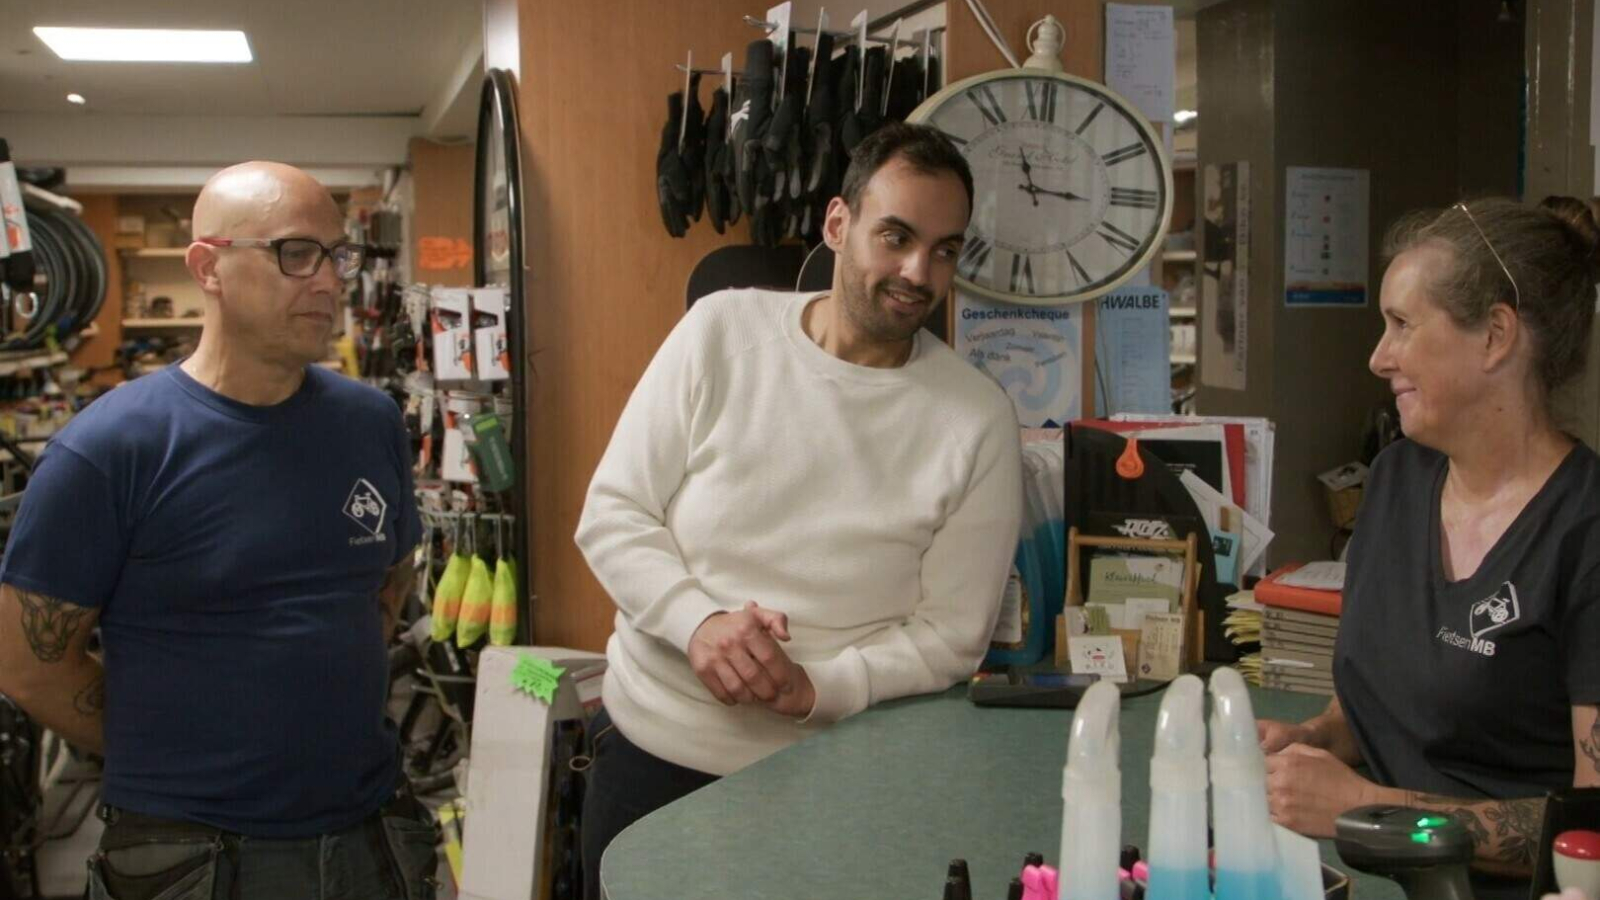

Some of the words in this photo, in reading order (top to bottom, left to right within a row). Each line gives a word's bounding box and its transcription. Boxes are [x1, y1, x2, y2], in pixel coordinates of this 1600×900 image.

[1021, 81, 1057, 123] XII
[962, 307, 1070, 321] Geschenkcheque
[965, 327, 1015, 343] Verjaardag
[968, 347, 984, 360] Als
[1436, 626, 1496, 656] FietsenMB
